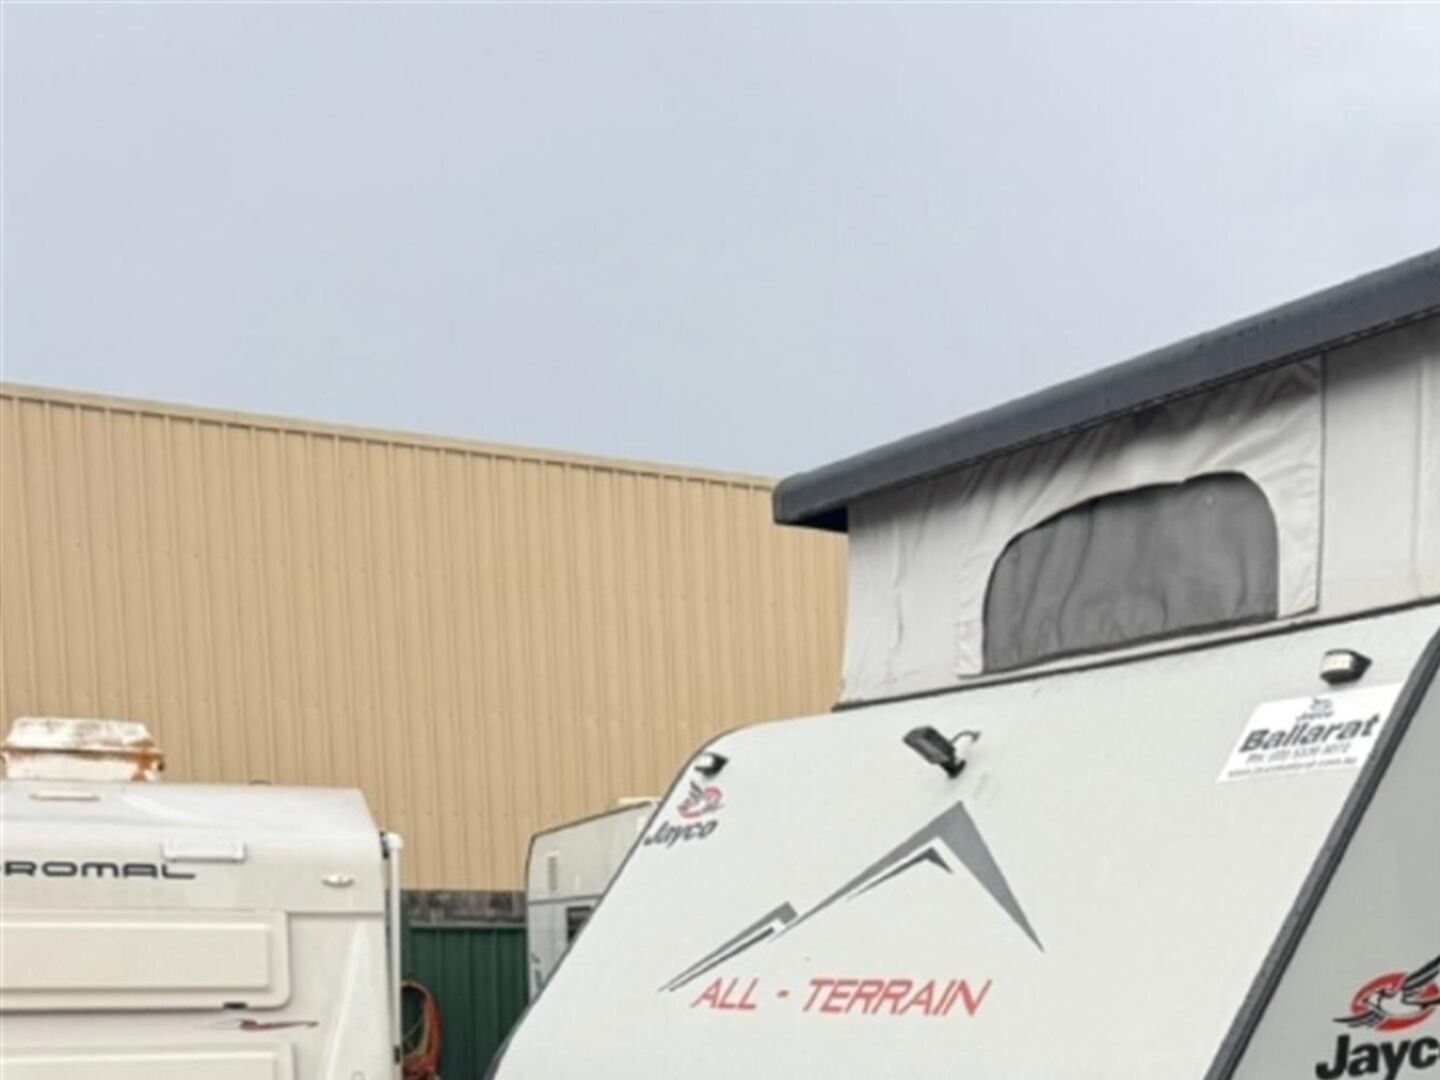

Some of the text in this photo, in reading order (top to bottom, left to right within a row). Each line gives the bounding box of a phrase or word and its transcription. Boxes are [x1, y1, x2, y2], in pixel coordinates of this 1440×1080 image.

[1239, 713, 1380, 753] Ballarat
[643, 820, 718, 848] Jayco
[0, 860, 196, 880] ROMAL
[691, 977, 760, 1011] ALL
[803, 978, 992, 1016] TERRAIN
